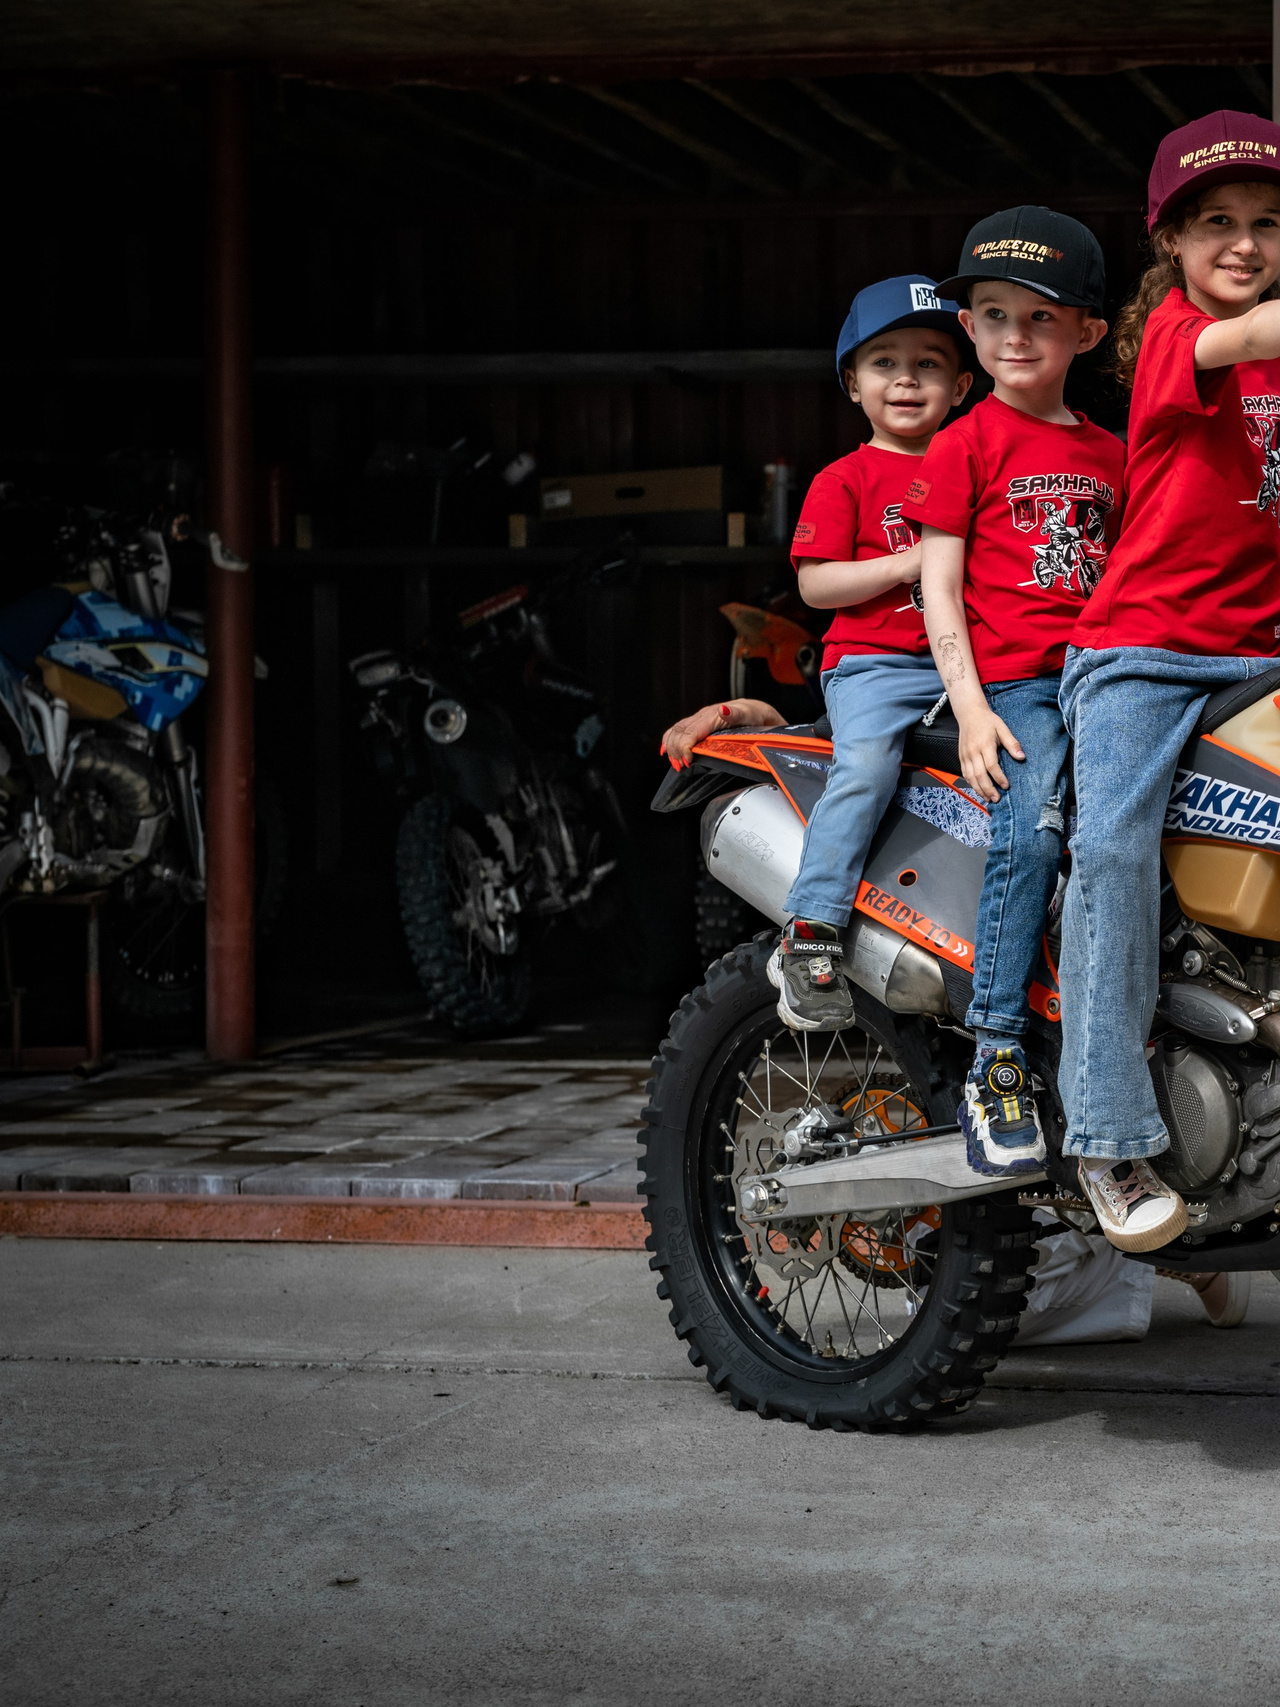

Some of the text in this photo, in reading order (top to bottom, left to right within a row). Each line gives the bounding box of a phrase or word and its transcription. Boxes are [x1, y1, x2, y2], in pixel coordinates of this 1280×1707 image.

[1179, 152, 1195, 168] NO
[1194, 140, 1236, 162] PLACE
[1238, 140, 1254, 151] TO
[1193, 153, 1227, 169] SINCE
[972, 243, 985, 257] NO
[984, 239, 1023, 253] PLACE
[1023, 240, 1039, 253] TO
[980, 250, 1045, 263] SINCE 2014
[1006, 473, 1115, 503] SAKHALIN
[862, 886, 952, 949] READY TO
[826, 945, 843, 953] KIDS
